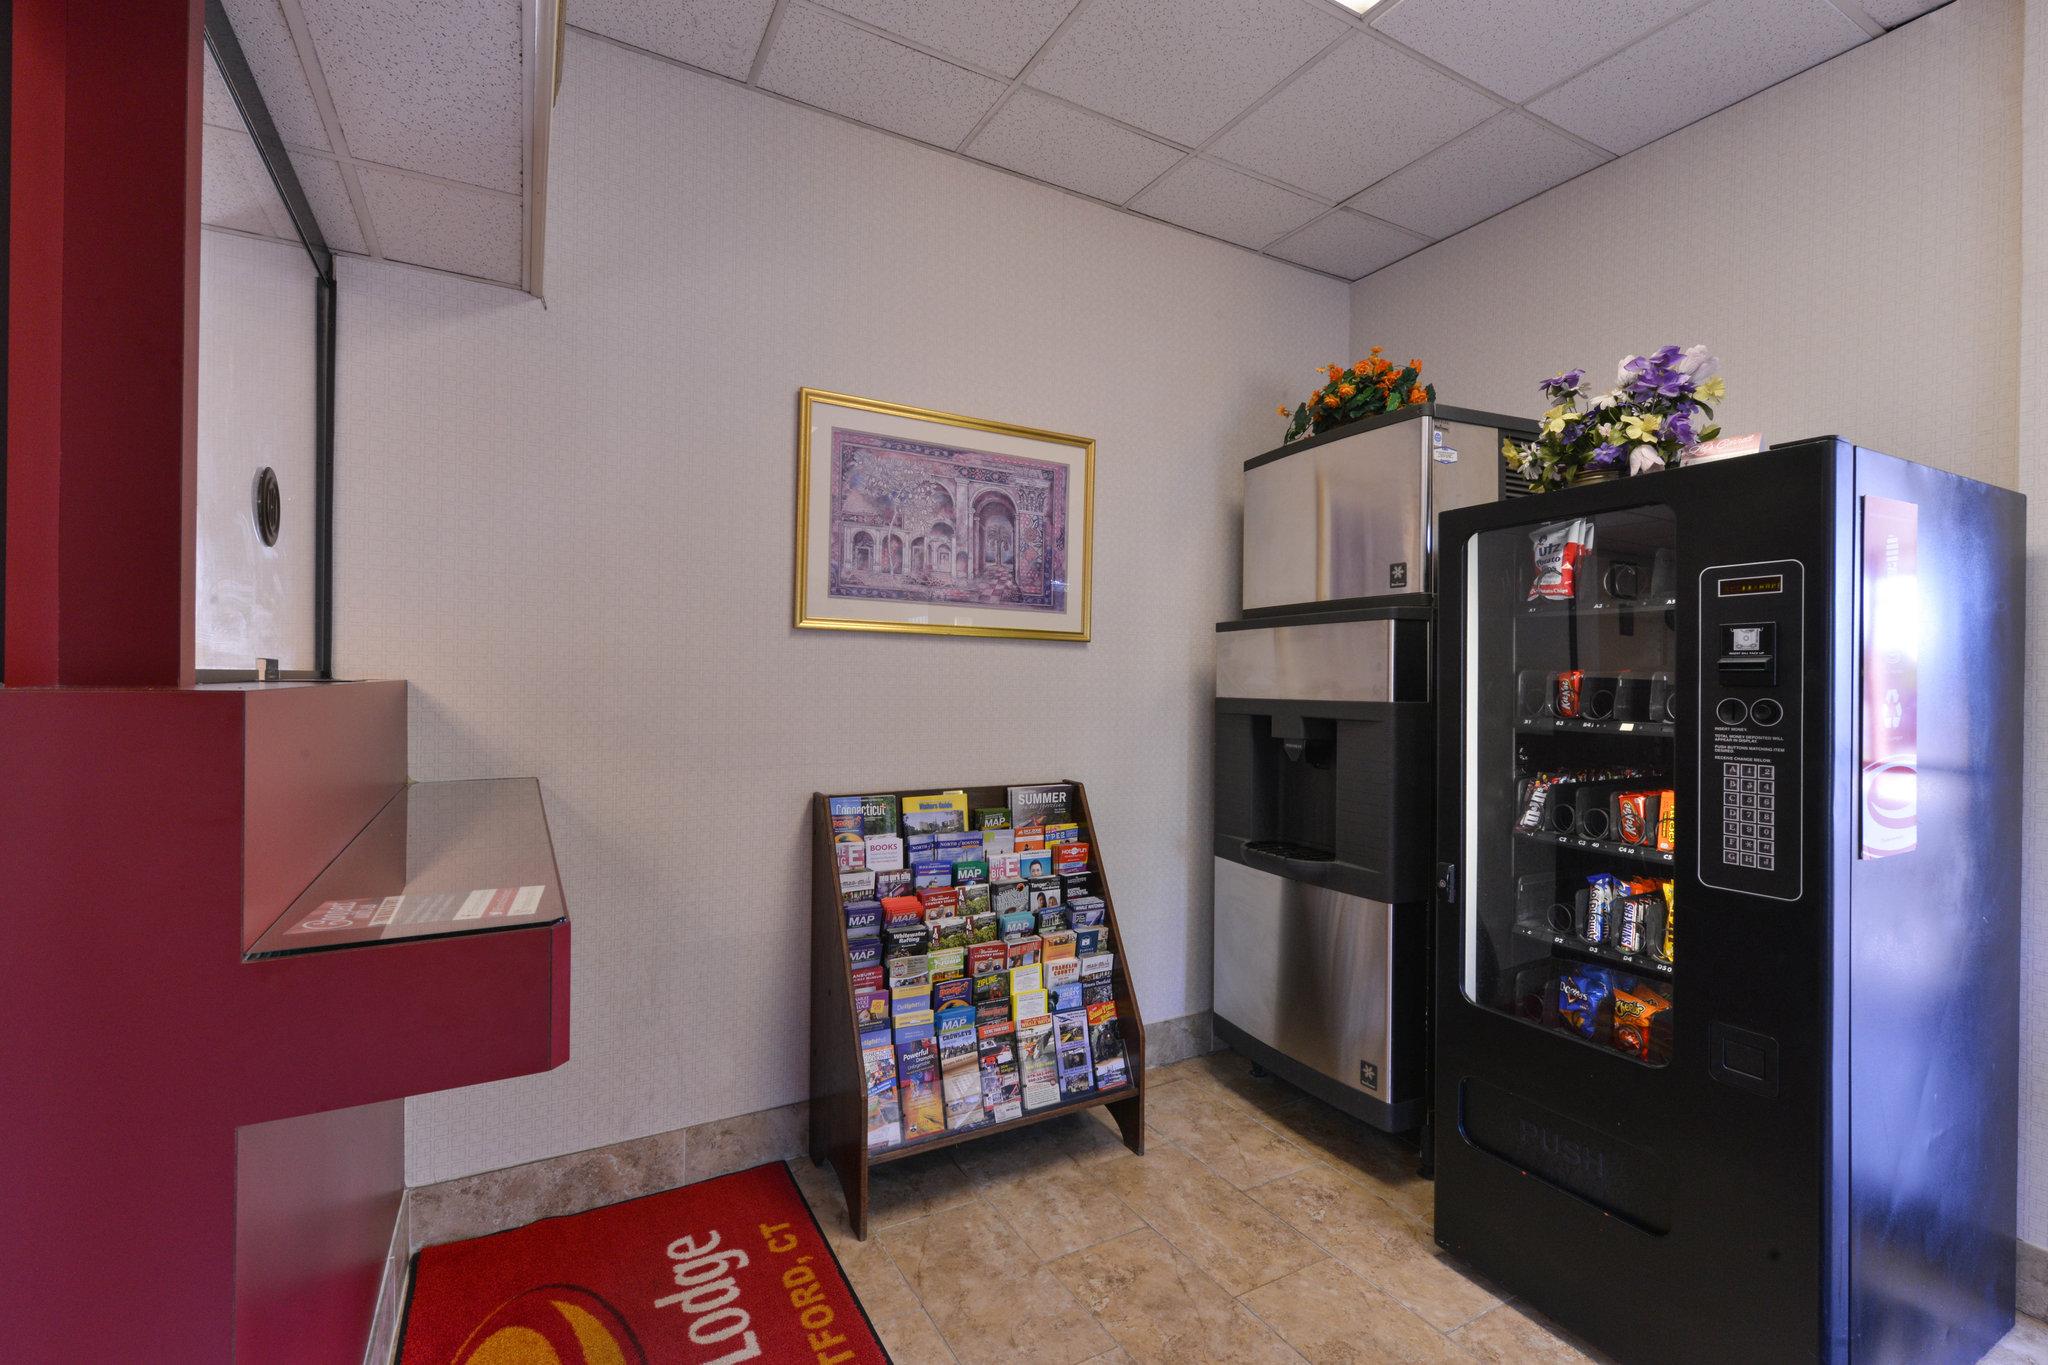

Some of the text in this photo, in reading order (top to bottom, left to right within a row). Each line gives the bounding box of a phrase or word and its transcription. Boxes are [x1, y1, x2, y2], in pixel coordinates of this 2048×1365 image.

[1018, 792, 1066, 805] SUMMER
[836, 802, 887, 816] Connecticut
[984, 818, 1006, 828] MAP
[870, 844, 898, 852] BOOKS
[958, 868, 982, 880] MAP
[991, 858, 1018, 881] BIG E
[849, 915, 875, 926] MAP
[892, 914, 916, 923] MAP
[1622, 902, 1636, 946] SNICKERS
[1007, 922, 1030, 932] MAP
[894, 932, 926, 940] Whitewater
[850, 950, 875, 960] MAP
[1052, 963, 1078, 971] FRANKLIN
[977, 975, 998, 988] ZIPLINE
[1560, 981, 1588, 1001] Doritos
[1616, 1000, 1644, 1016] Cheetos
[942, 1018, 967, 1030] MAP
[942, 1030, 972, 1041] CROWLEYS
[903, 1048, 928, 1061] Powerful
[916, 1054, 934, 1063] Dramatic
[1520, 1119, 1606, 1172] PUSH
[758, 1222, 798, 1254] CT
